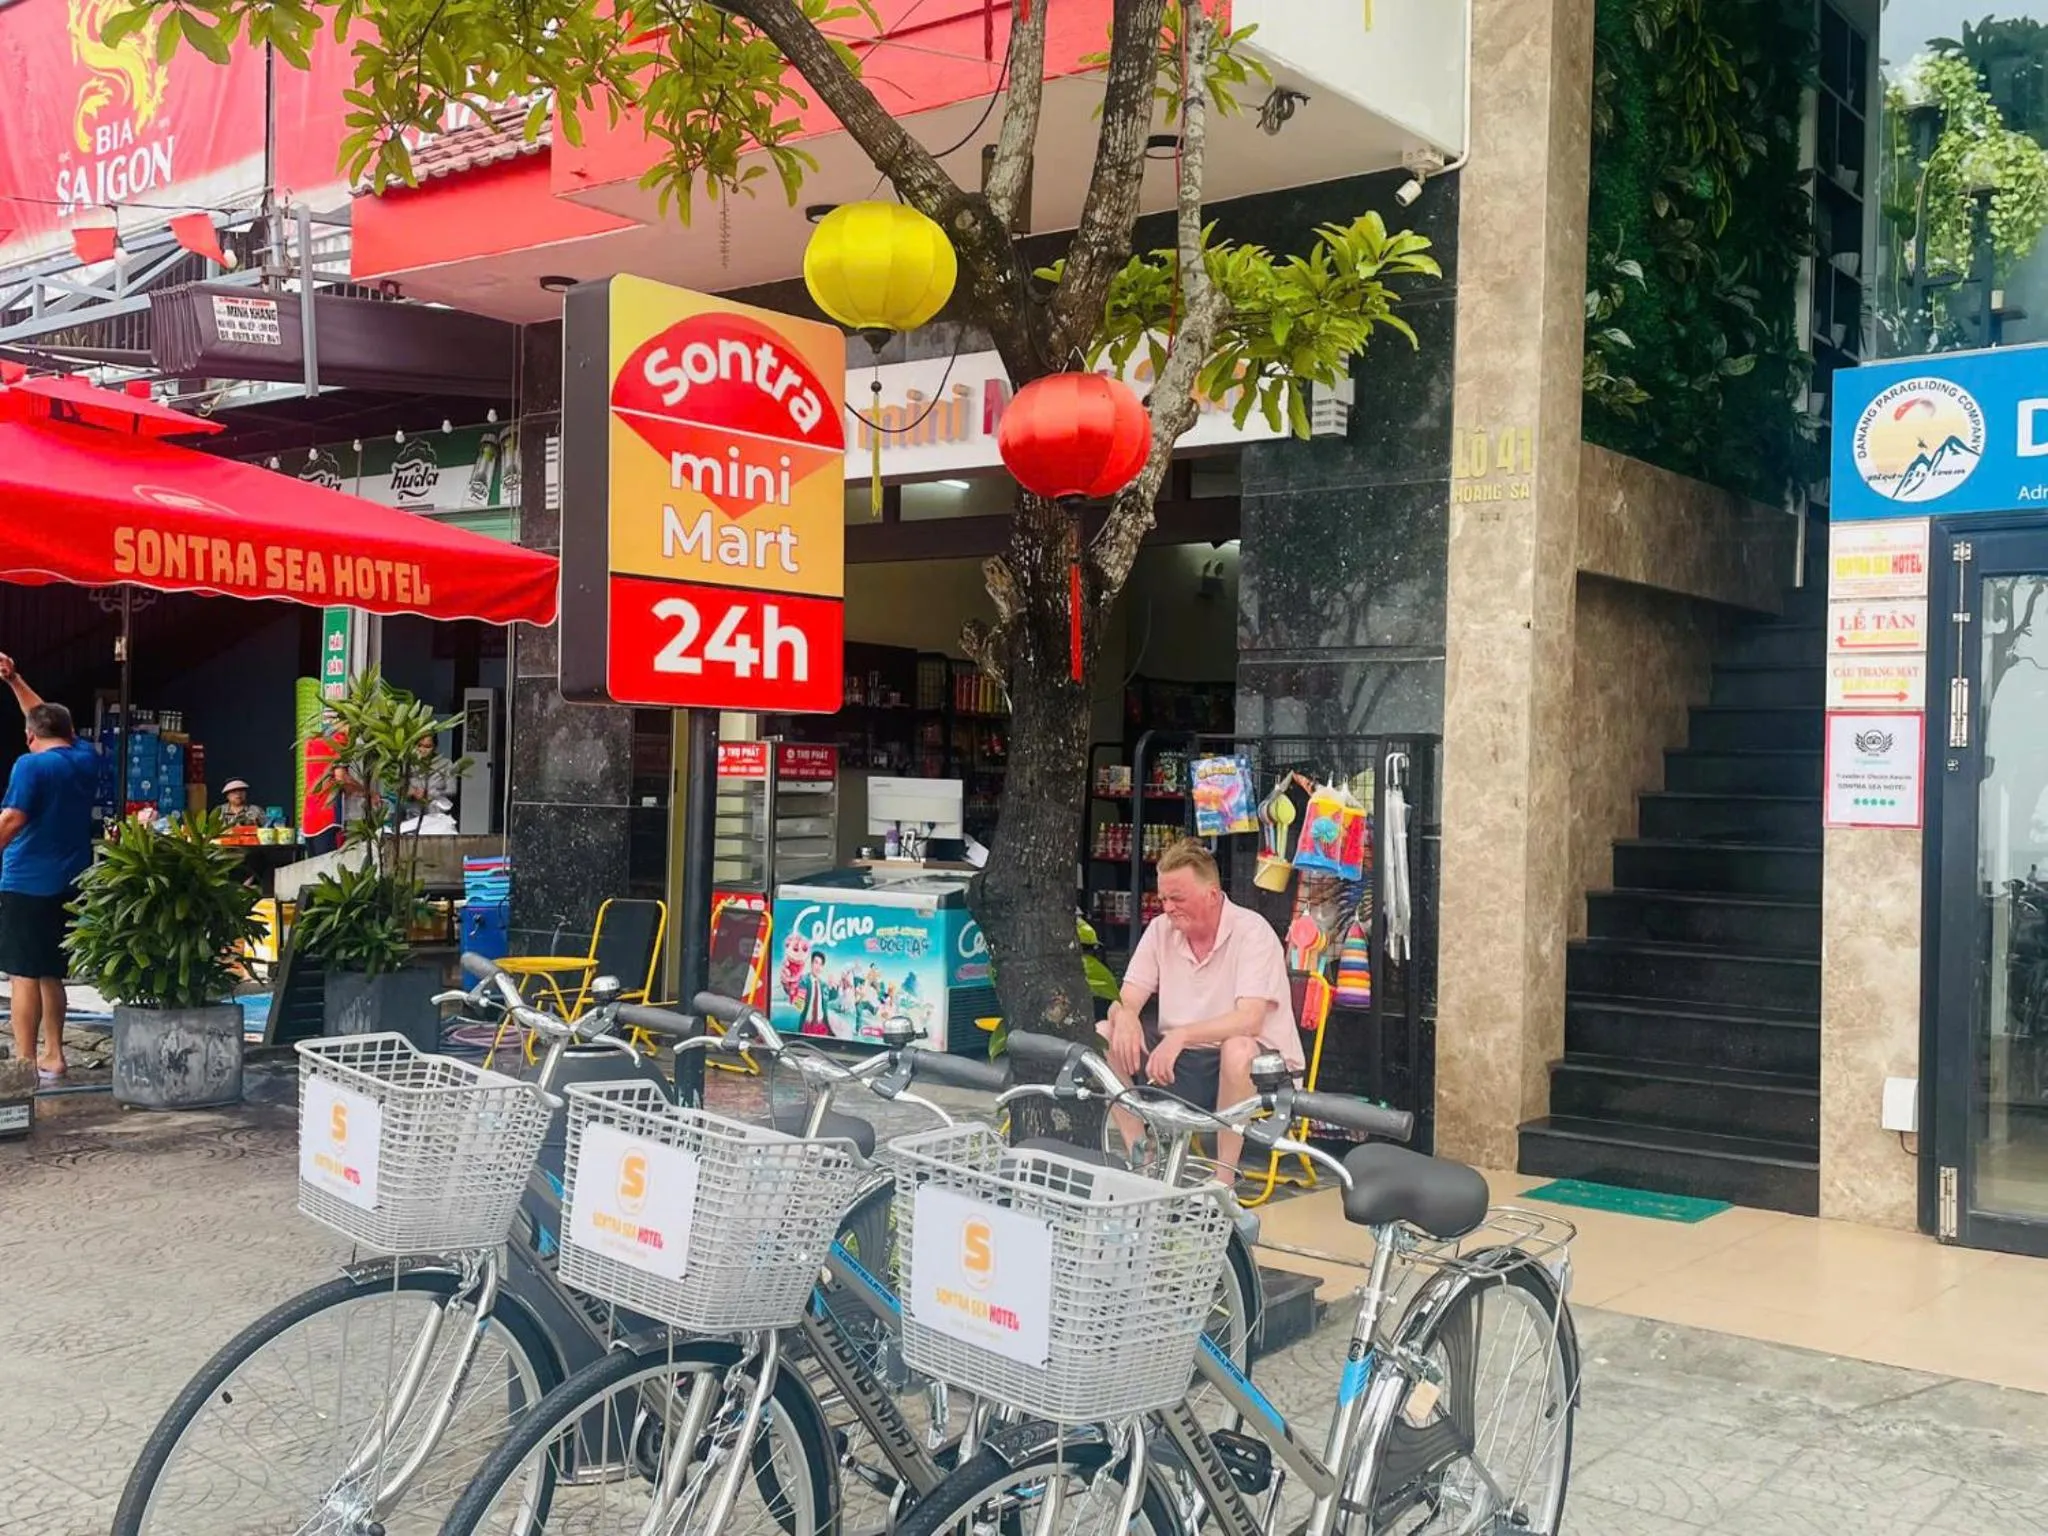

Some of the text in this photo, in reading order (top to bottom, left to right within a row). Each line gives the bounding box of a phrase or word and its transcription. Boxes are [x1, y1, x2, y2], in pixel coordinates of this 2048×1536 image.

[96, 116, 134, 155] BIA
[642, 337, 823, 434] Sontra
[858, 384, 969, 451] mini
[1857, 380, 1982, 460] DANANG PARAGLIDING COMPANY
[1495, 425, 1534, 476] 41
[391, 463, 439, 500] huda
[671, 445, 793, 506] mini
[1510, 481, 1531, 500] SA
[661, 503, 801, 575] Mart
[1891, 552, 1922, 575] HOTEL
[113, 525, 432, 606] SONTRA SEA HOTEL
[650, 597, 811, 682] 24h
[793, 905, 875, 947] Celano
[620, 1155, 646, 1198] S
[637, 1226, 664, 1250] HOTEL
[964, 1222, 991, 1271] S
[989, 1304, 1020, 1332] HOTEL
